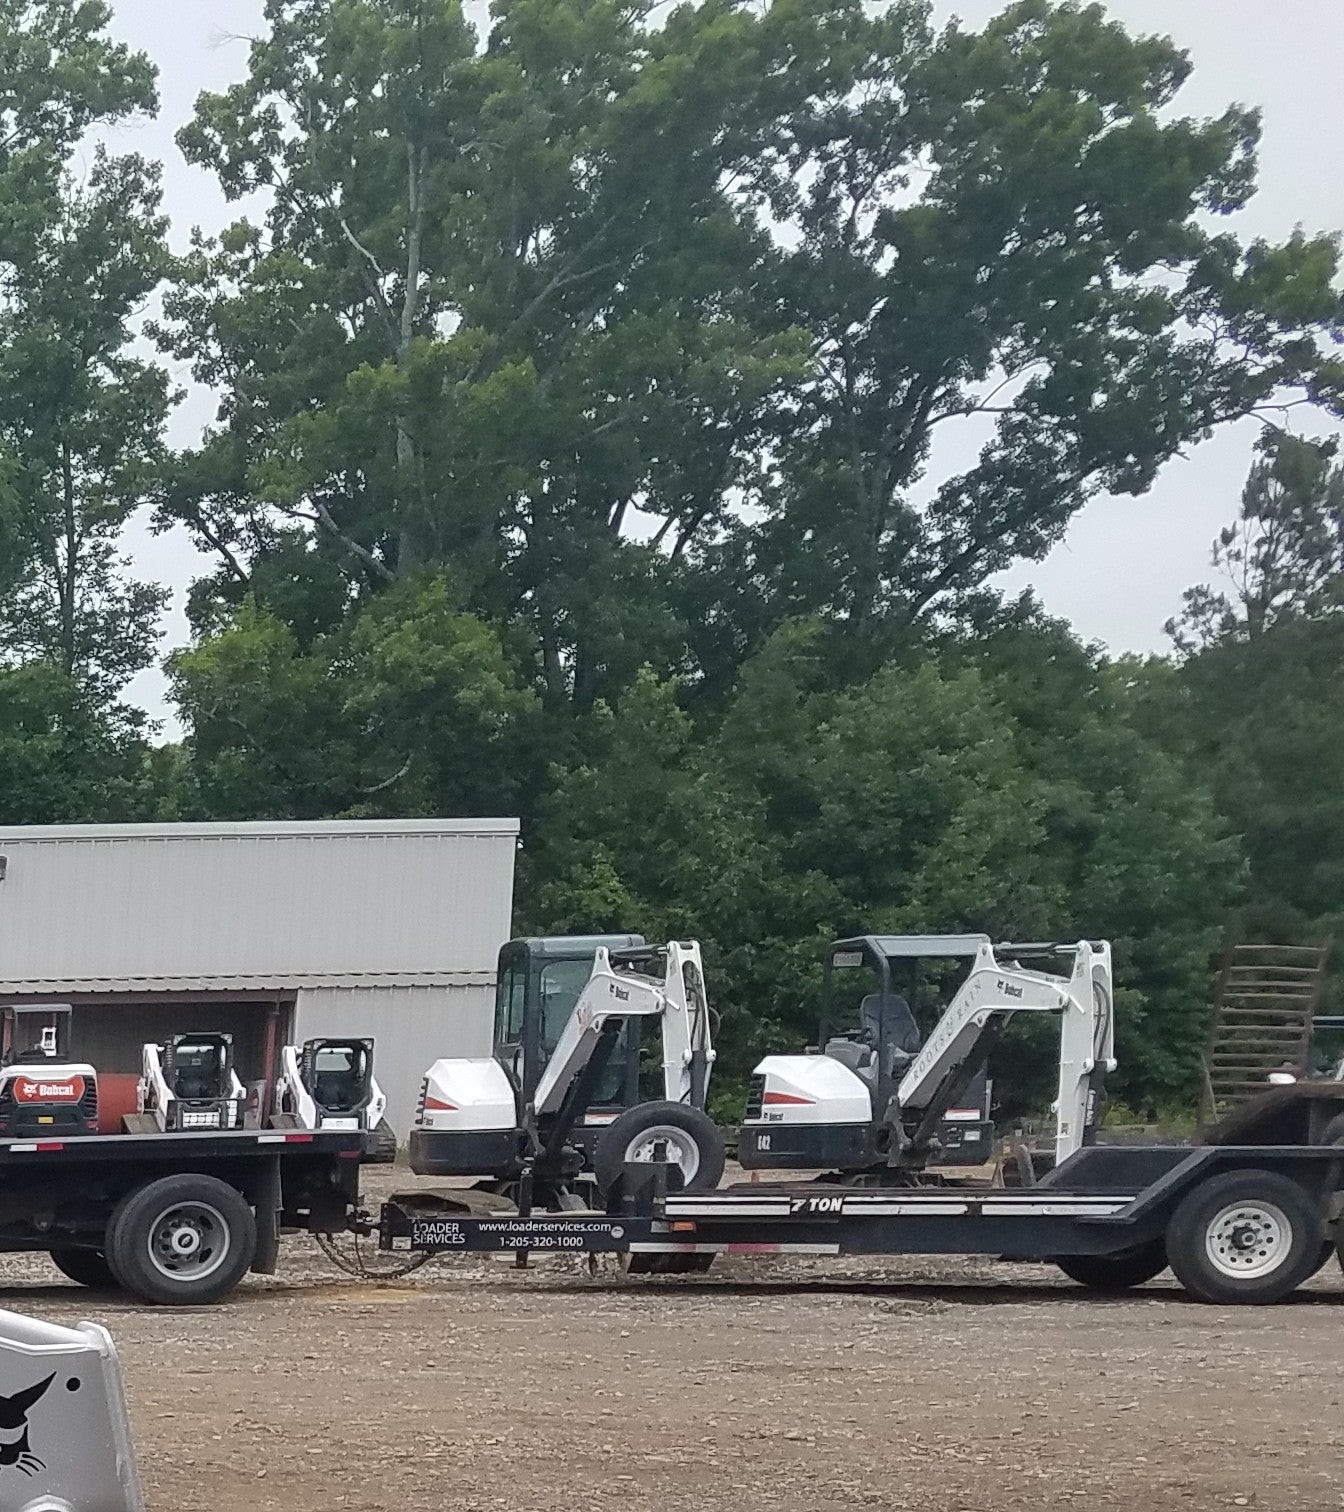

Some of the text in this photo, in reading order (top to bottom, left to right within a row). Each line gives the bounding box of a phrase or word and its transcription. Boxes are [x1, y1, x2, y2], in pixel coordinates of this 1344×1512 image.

[39, 1085, 74, 1096] Bobcat
[757, 1135, 771, 1150] E42
[809, 1198, 844, 1212] TON
[414, 1222, 459, 1233] LOADER
[478, 1221, 611, 1232] www.loaderservices.com
[413, 1233, 465, 1244] SERVICES
[499, 1236, 583, 1247] 1-205-320-1000
